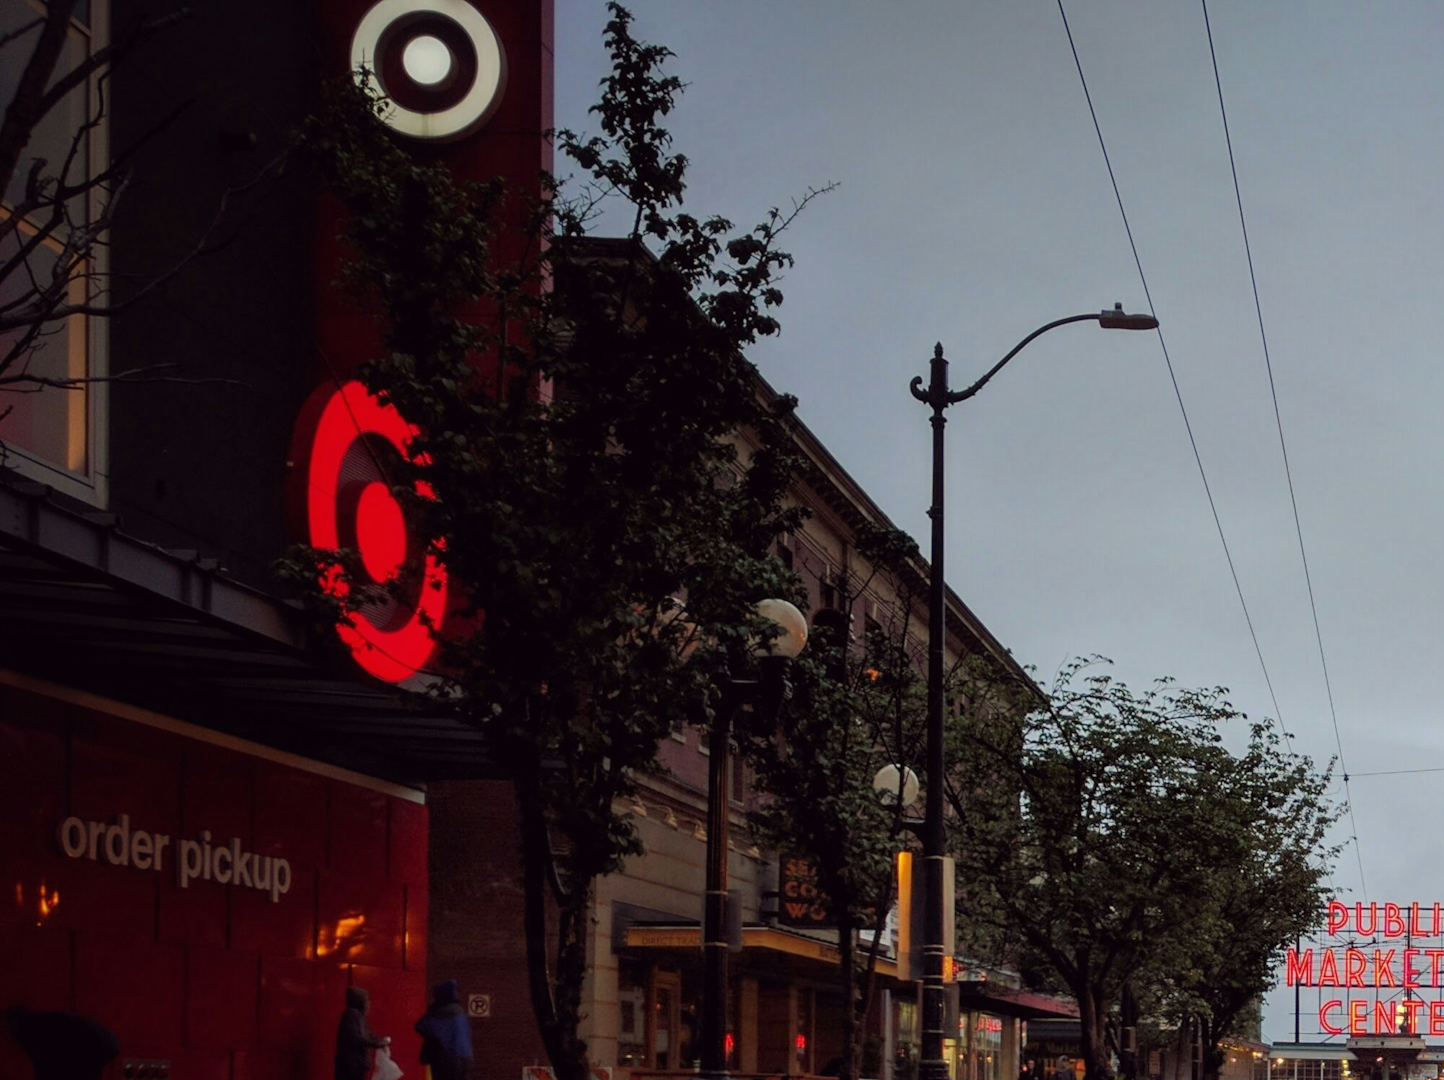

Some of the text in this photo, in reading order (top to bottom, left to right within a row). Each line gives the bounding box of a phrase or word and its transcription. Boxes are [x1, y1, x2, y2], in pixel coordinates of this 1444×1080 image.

[60, 813, 292, 903] order pickup
[676, 936, 701, 946] TRAD
